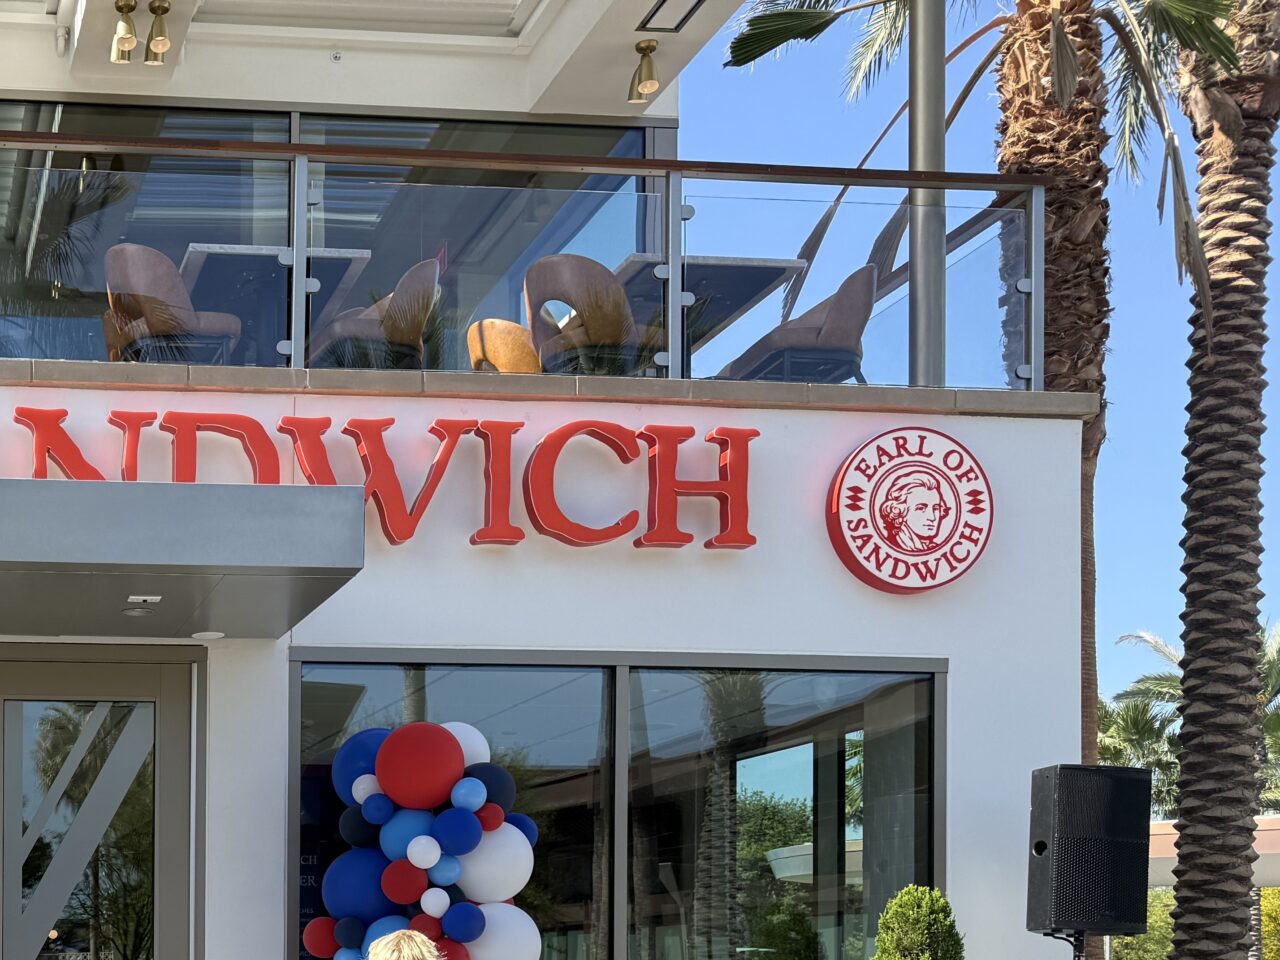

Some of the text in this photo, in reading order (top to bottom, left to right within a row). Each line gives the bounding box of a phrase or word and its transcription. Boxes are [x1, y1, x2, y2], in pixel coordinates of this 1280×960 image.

[854, 435, 980, 484] EARL OF
[846, 517, 984, 583] SANDWICH
